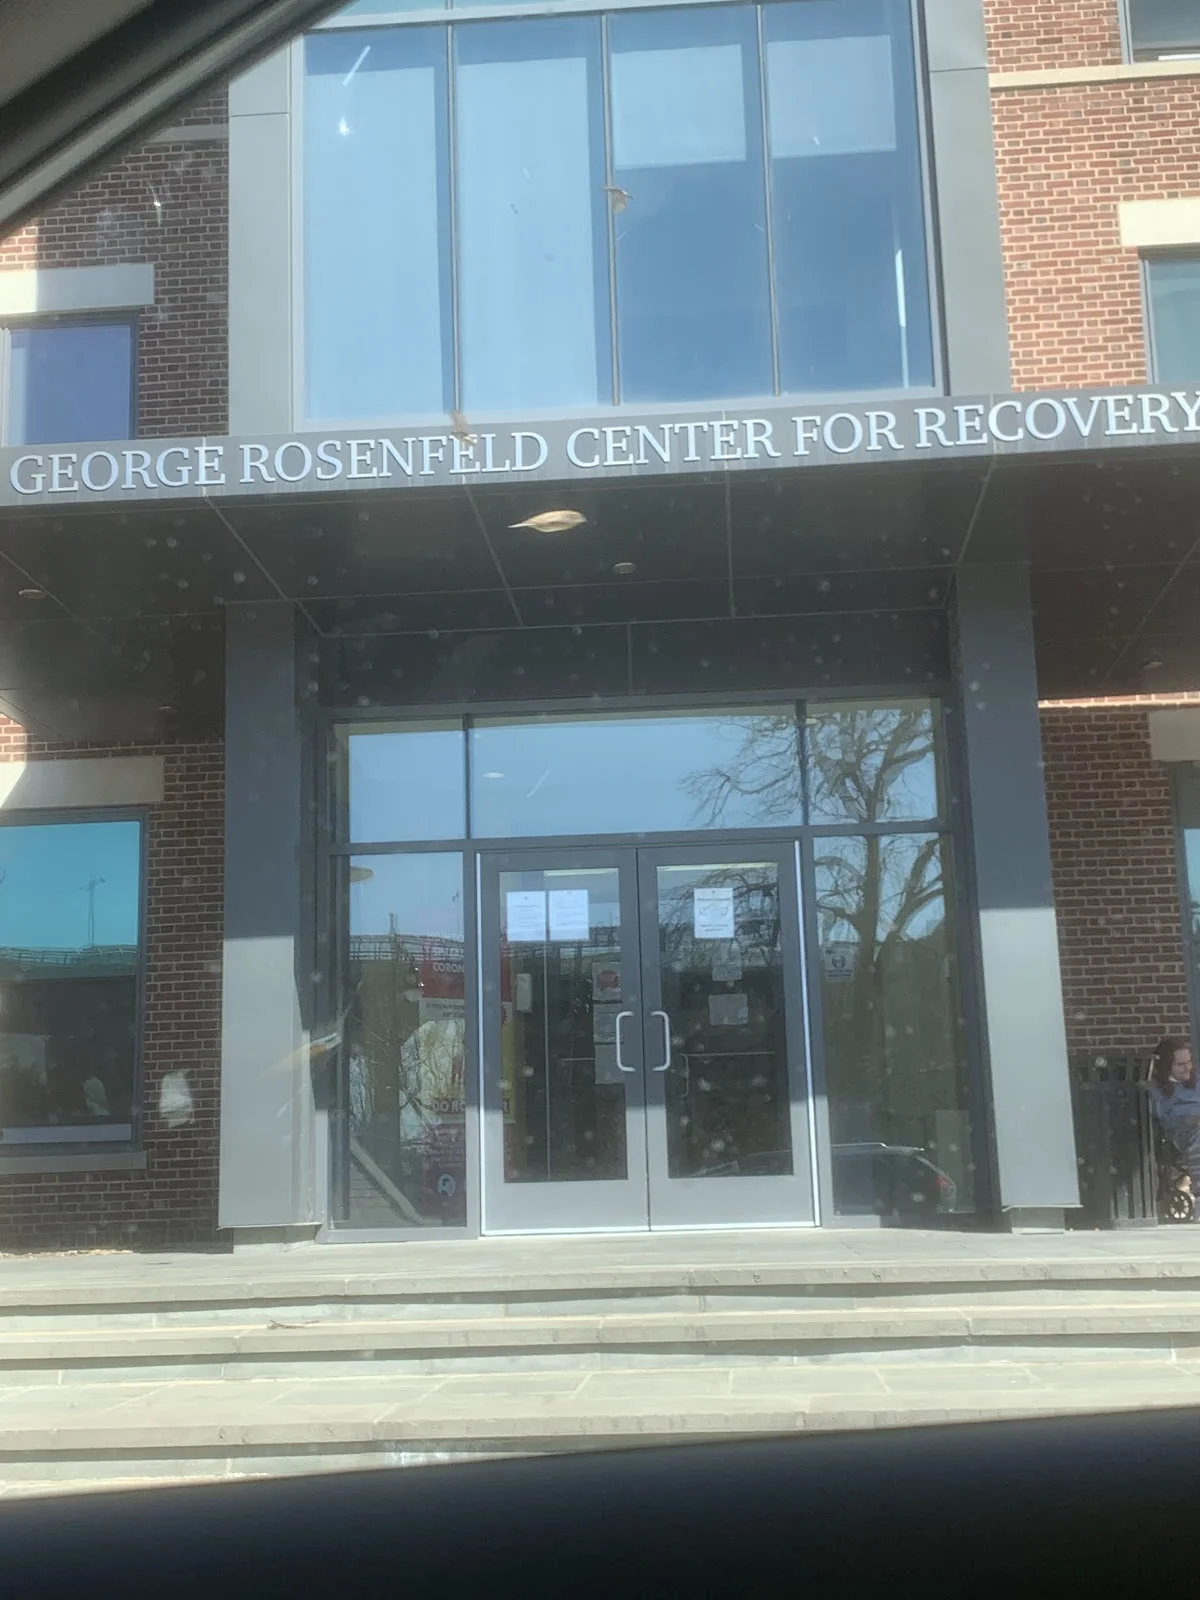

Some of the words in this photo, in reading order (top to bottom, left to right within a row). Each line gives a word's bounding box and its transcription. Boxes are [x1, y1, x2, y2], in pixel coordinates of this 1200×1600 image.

[9, 446, 226, 494] GEORGE
[239, 431, 549, 484] ROSENFELD
[566, 417, 781, 468] CENTER
[791, 410, 904, 457] FOR
[914, 390, 1200, 449] RECOVERY
